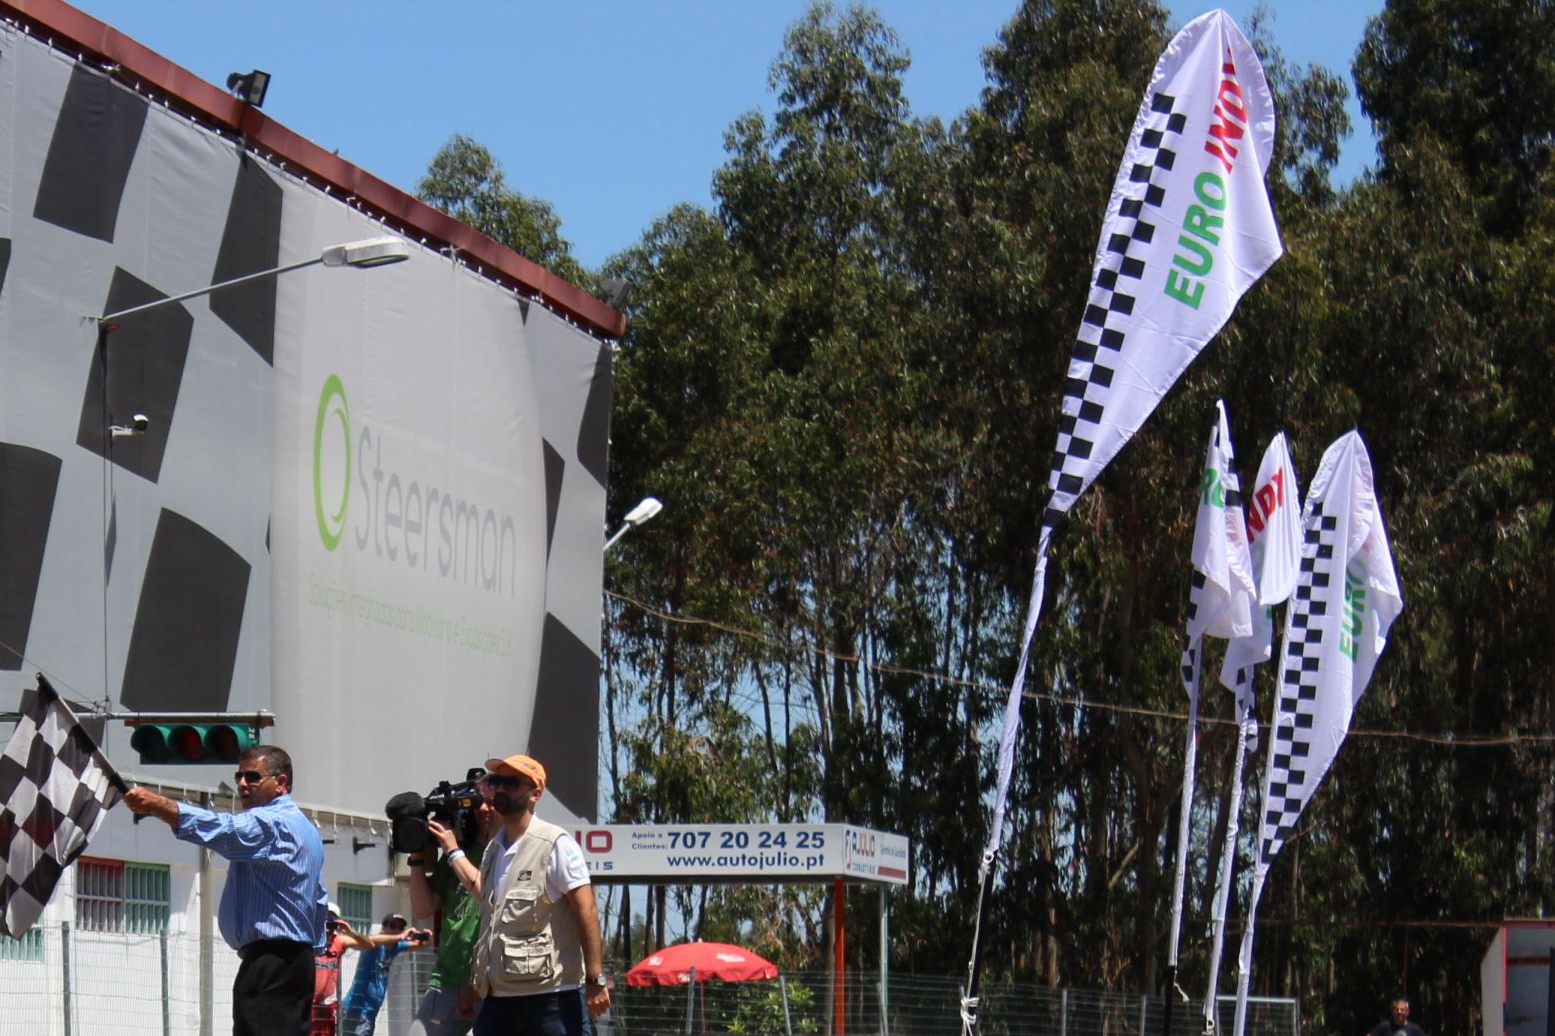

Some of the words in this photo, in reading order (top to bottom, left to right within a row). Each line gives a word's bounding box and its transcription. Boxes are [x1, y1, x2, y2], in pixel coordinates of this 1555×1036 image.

[1164, 171, 1227, 310] EURO
[667, 831, 711, 849] 707
[720, 831, 749, 849] 20
[758, 831, 787, 849] 24
[795, 831, 825, 849] 25
[667, 852, 825, 870] www.autojulio.pt
